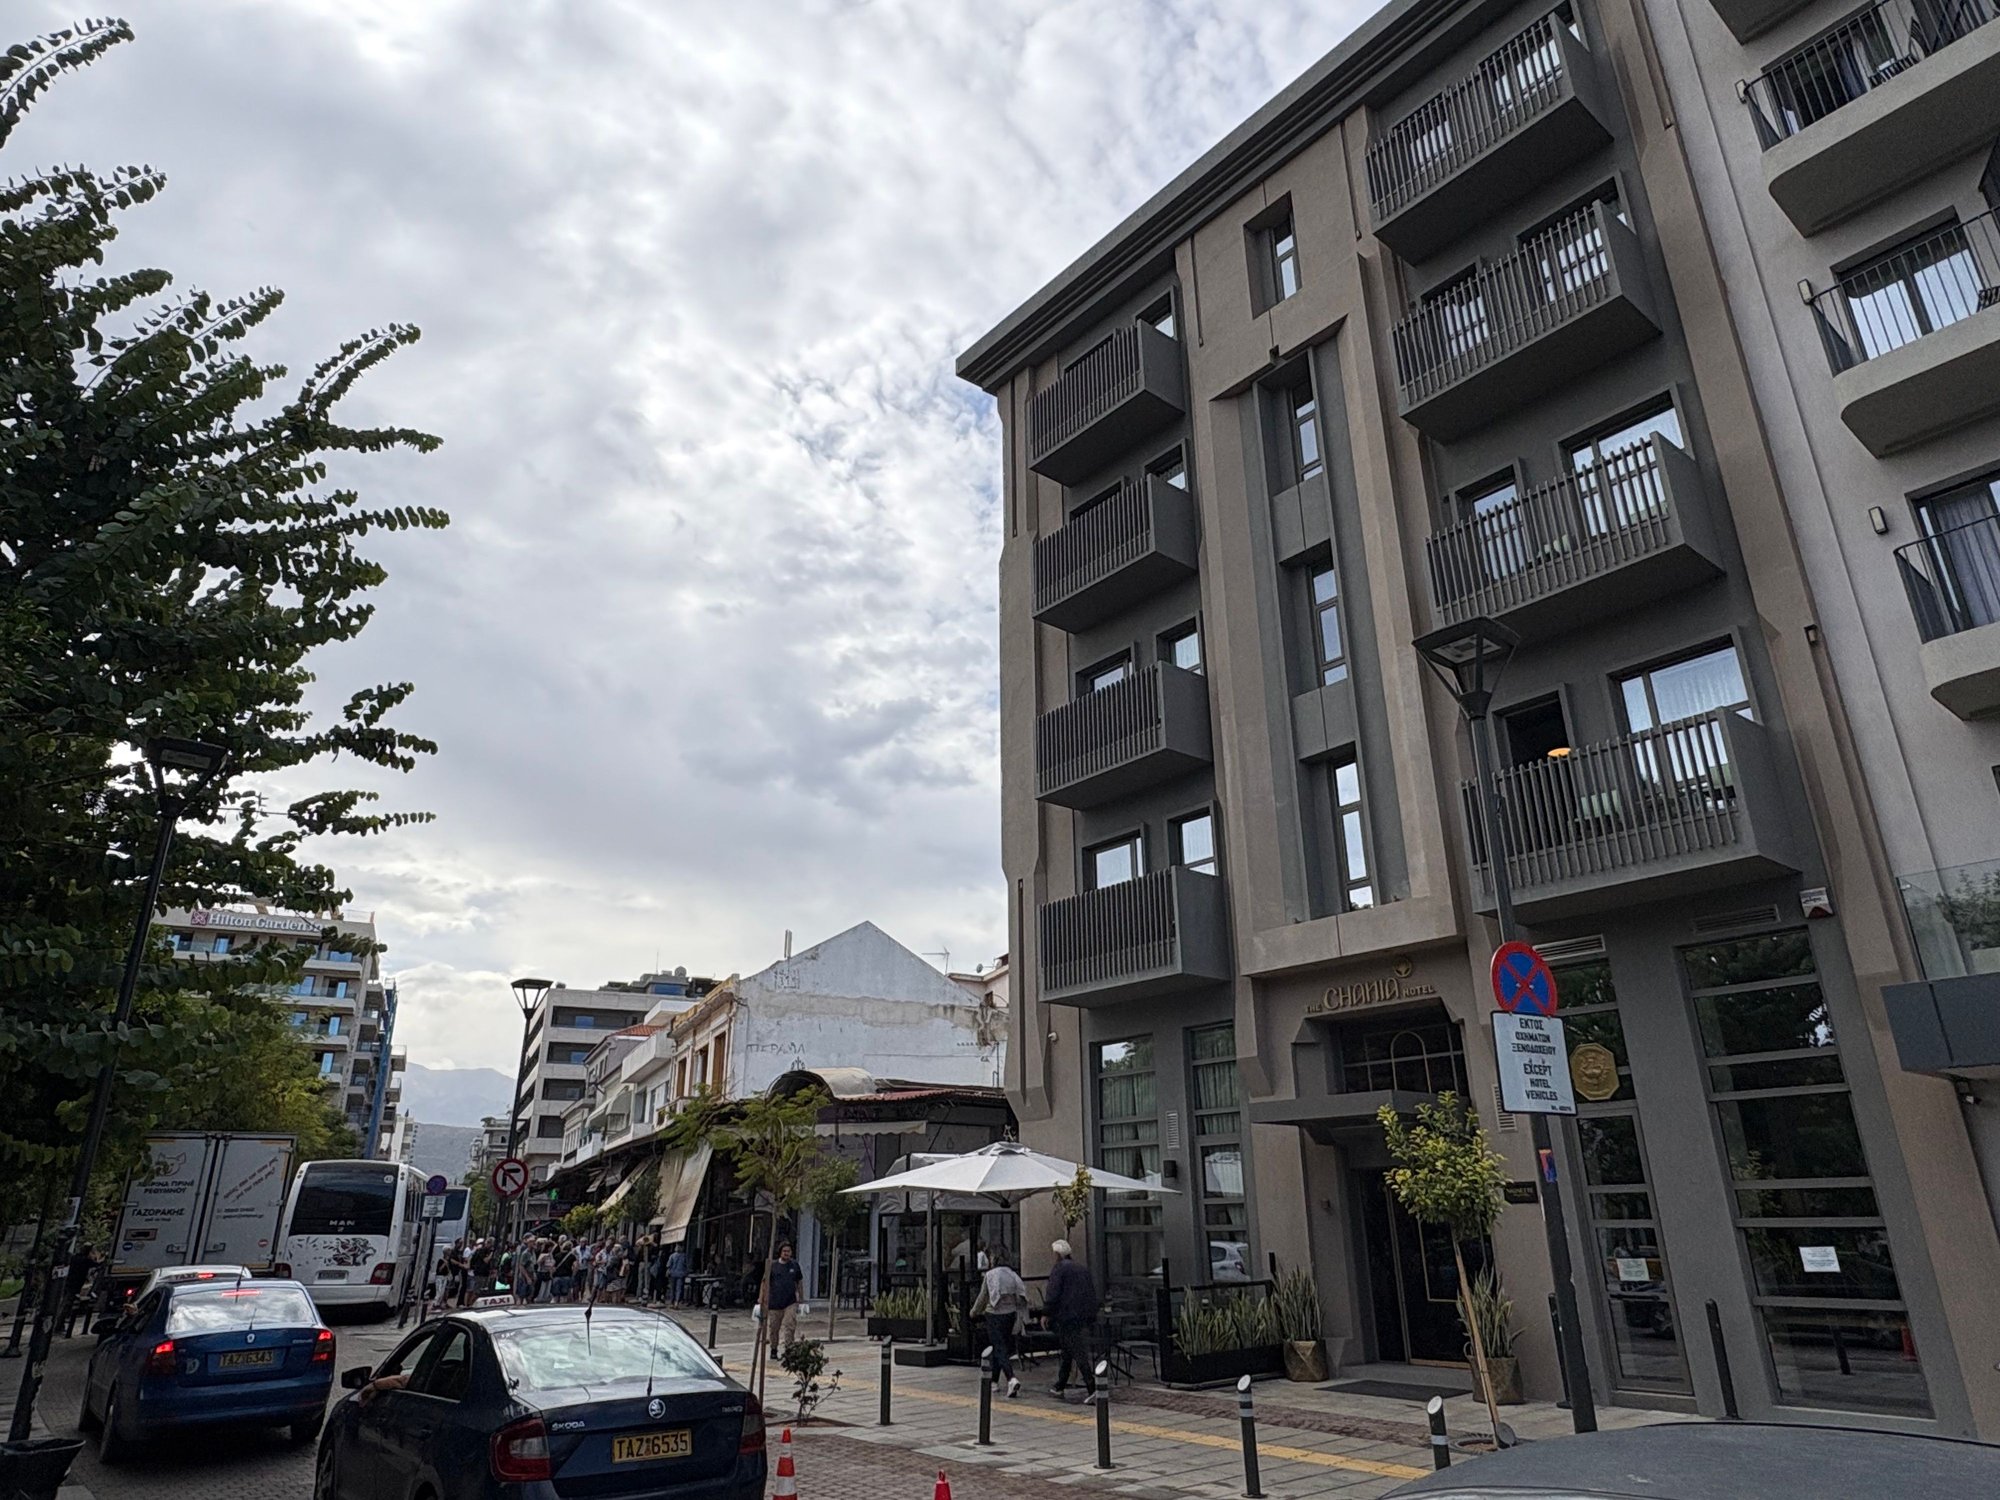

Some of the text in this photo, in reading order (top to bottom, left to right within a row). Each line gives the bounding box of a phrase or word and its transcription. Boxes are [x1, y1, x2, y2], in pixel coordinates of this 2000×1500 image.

[208, 913, 251, 927] Hilton
[255, 917, 307, 931] Garden
[1402, 984, 1434, 997] HOTEL
[1519, 1017, 1545, 1031] ΕΚΤΟΣ
[1523, 1063, 1552, 1076] EXCEPT
[1529, 1079, 1552, 1089] HOTEL
[1525, 1089, 1558, 1101] VEHICLES
[131, 1207, 185, 1217] ΓΑΖΟΡΑΚΗΣ
[483, 1296, 511, 1307] TAXI
